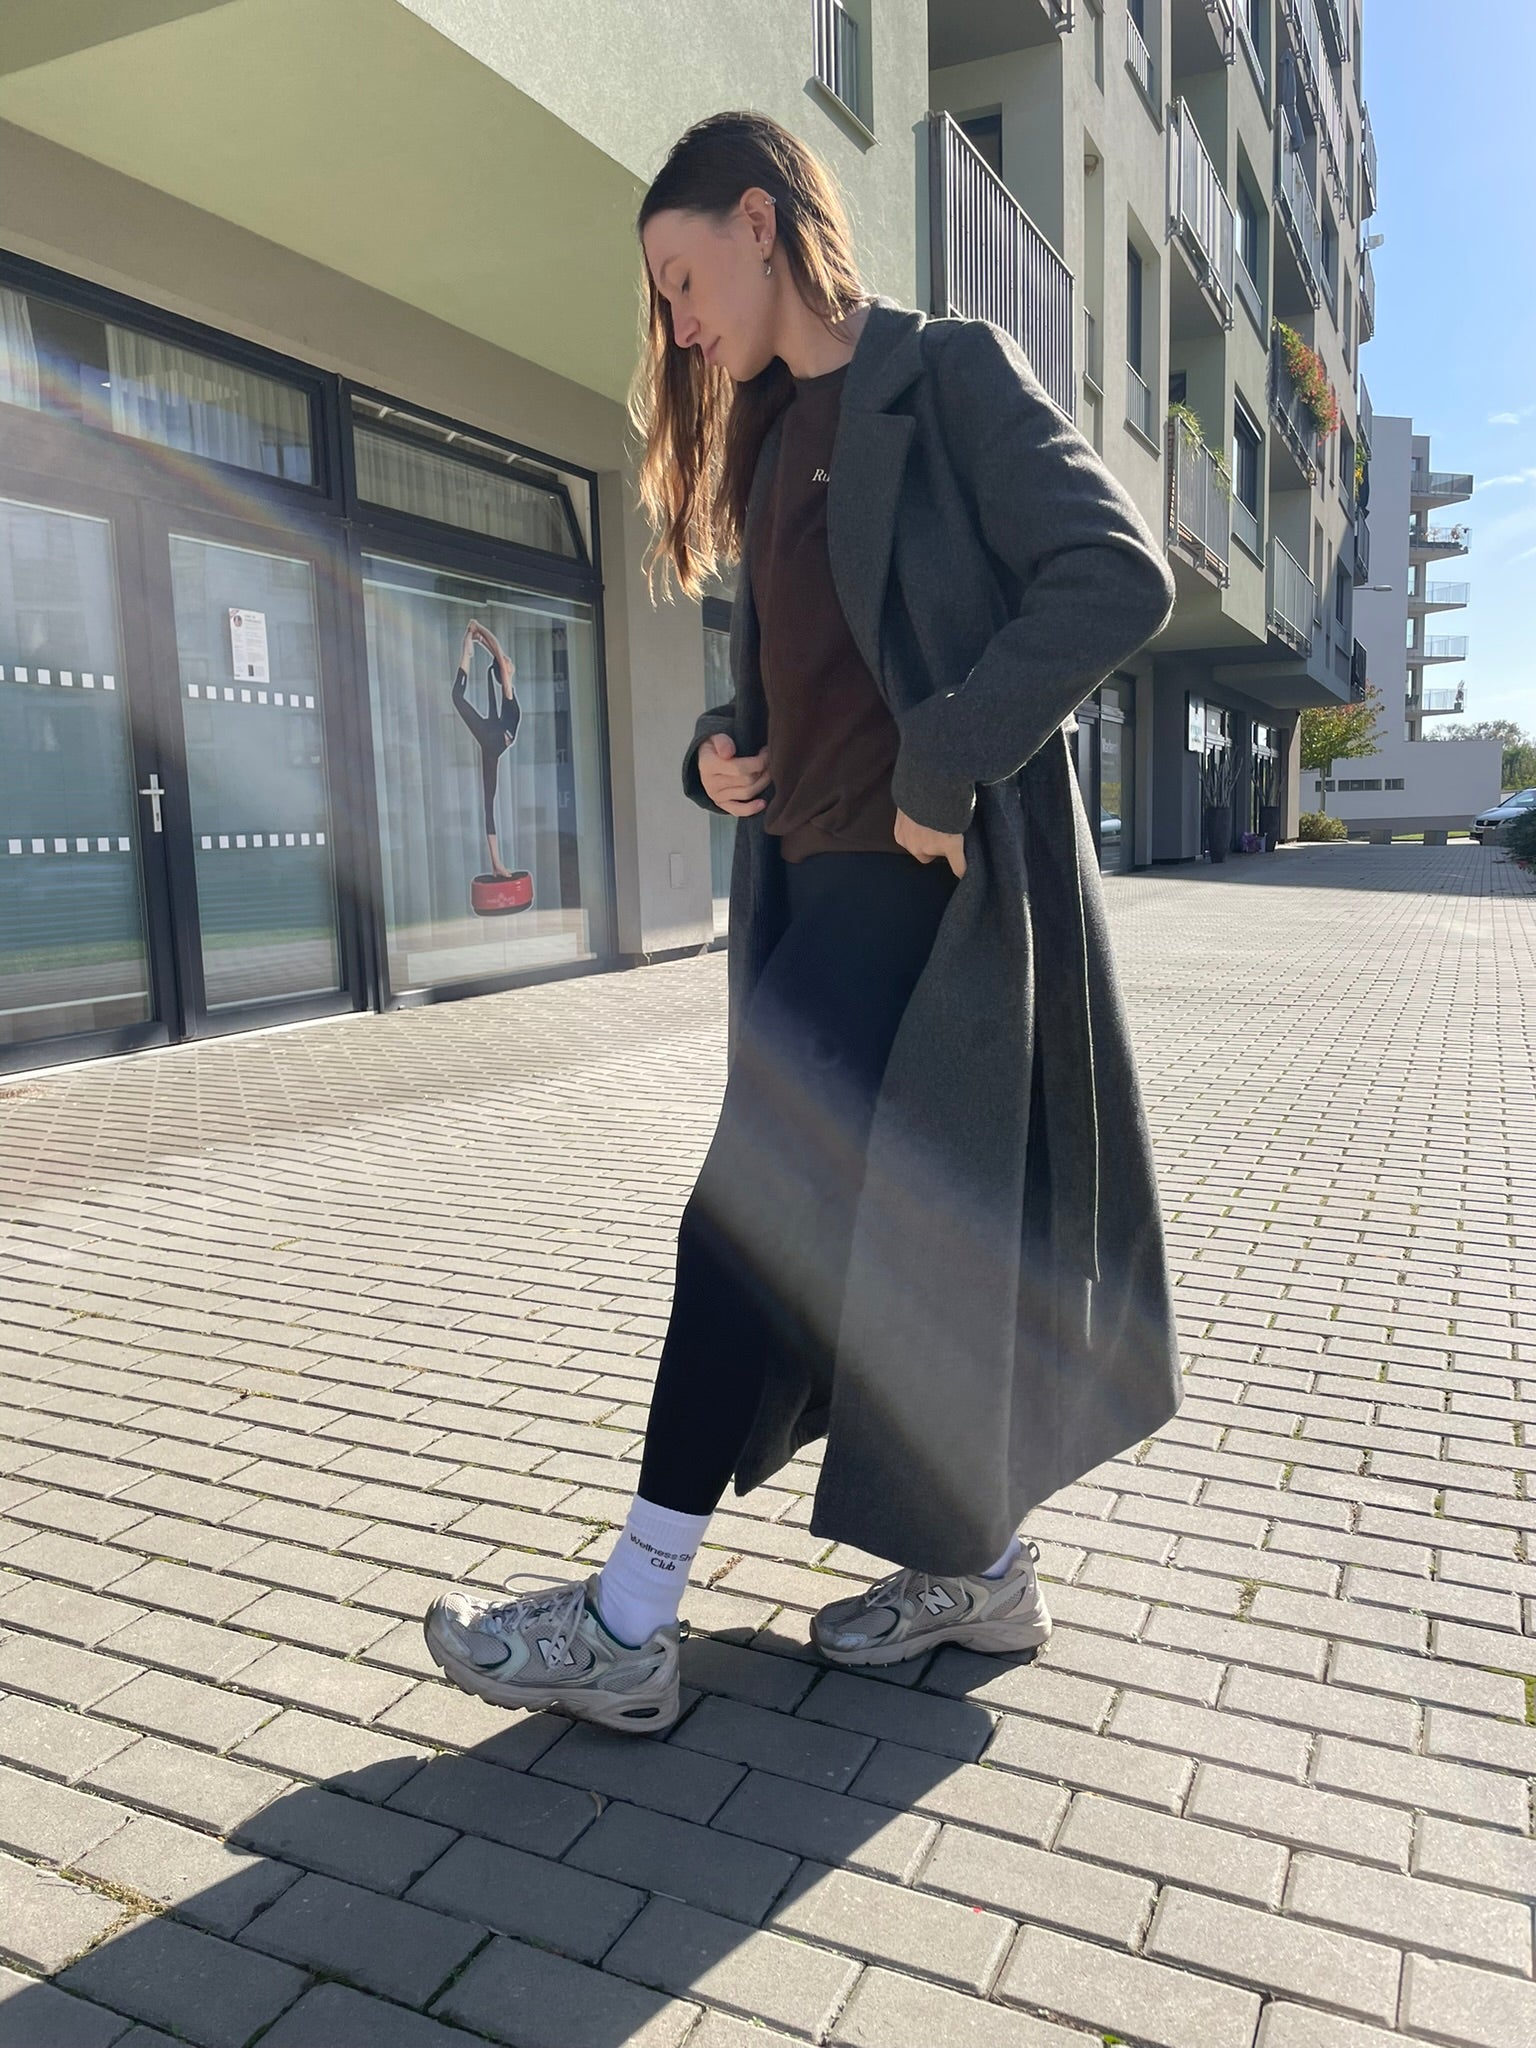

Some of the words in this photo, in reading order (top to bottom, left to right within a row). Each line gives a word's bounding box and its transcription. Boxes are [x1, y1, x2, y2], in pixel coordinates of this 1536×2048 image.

[630, 1532, 678, 1561] Wellness
[650, 1557, 676, 1571] Club
[917, 1584, 958, 1616] N
